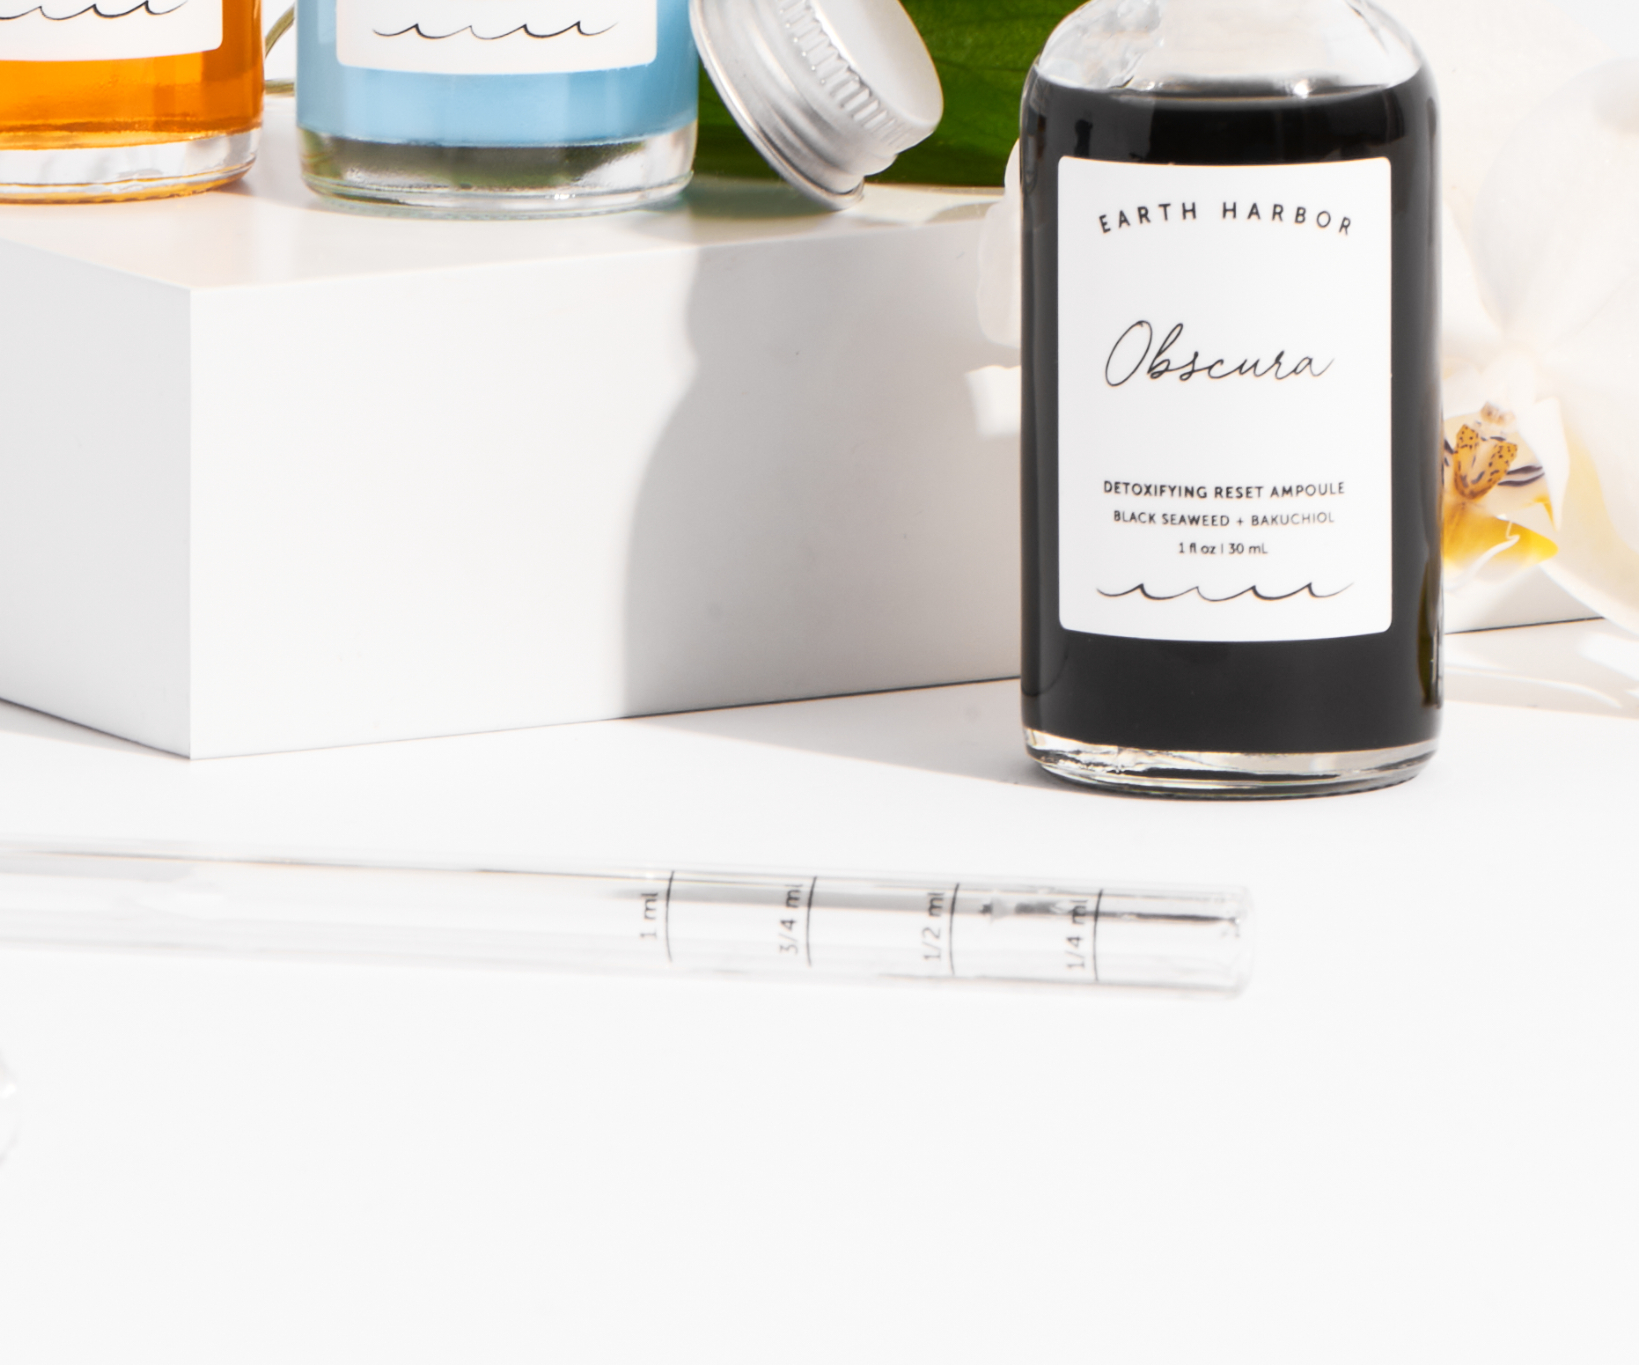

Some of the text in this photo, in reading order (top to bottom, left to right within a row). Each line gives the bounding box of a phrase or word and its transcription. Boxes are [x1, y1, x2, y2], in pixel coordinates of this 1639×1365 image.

[1098, 201, 1352, 235] EARTH HARBOR
[1104, 319, 1336, 388] Obscura
[1103, 479, 1343, 500] DETOXIFYING RESET AMPOULE
[1113, 509, 1336, 527] BLACK SEAWEED + BAKUCHIOL
[1178, 541, 1186, 555] 1
[1188, 541, 1197, 554] fl
[1199, 544, 1217, 555] oz
[1228, 542, 1245, 555] 30
[1247, 543, 1268, 555] mL
[639, 892, 658, 941] 1 ml
[779, 884, 802, 955] 3/4 ml
[923, 892, 944, 961] 1/2 ml
[1066, 899, 1088, 969] 1/4 ml
